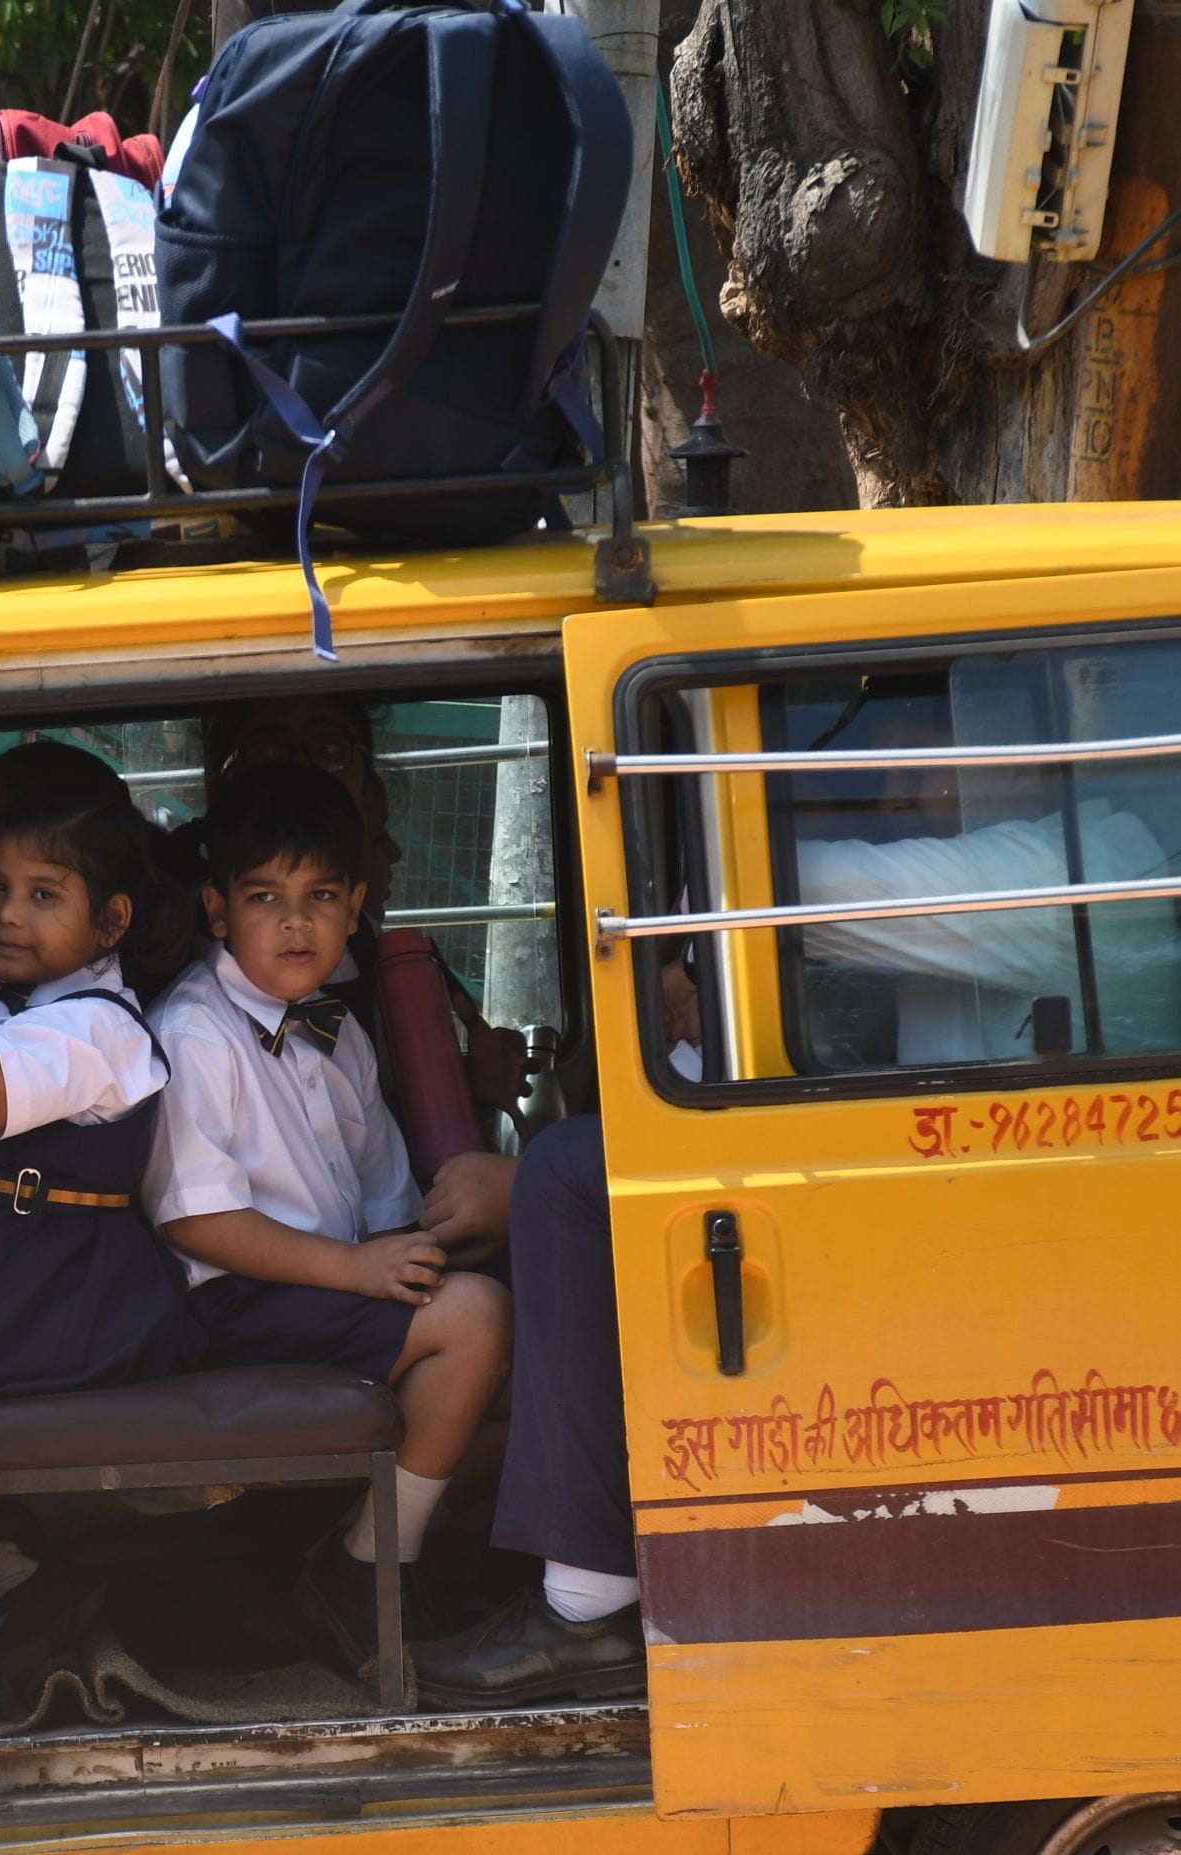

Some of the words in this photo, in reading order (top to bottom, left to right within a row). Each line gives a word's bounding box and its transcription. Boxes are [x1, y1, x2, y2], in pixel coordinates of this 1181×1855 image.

[661, 1416, 719, 1492] इस
[804, 1383, 838, 1465] की
[843, 1378, 1006, 1467] अधिकतम
